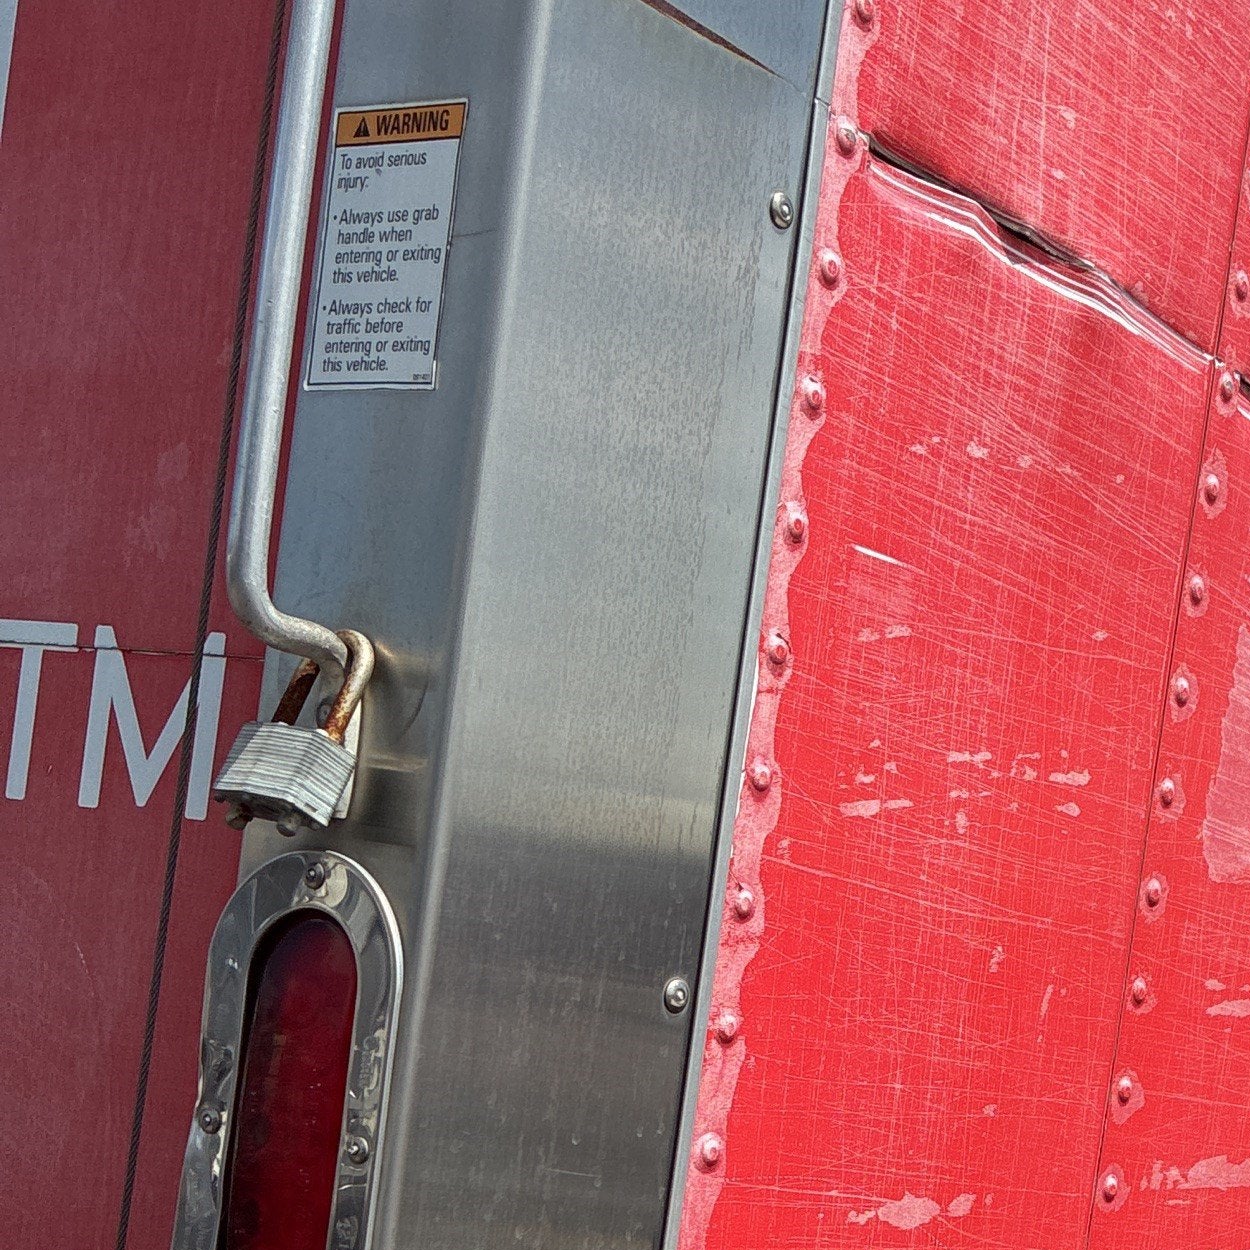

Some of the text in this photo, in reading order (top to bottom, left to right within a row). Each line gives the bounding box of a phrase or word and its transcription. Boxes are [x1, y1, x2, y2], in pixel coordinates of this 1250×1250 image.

[376, 110, 450, 136] WARNING
[341, 150, 427, 170] To avoid serious
[337, 173, 369, 192] injury:
[339, 204, 439, 226] Always use grab
[337, 227, 412, 245] handle when
[335, 245, 441, 267] entering or exiting
[333, 265, 399, 284] this vehicle.
[328, 297, 432, 319] Always check for
[327, 315, 404, 335] traffic before
[325, 335, 431, 357] entering or exiting
[322, 354, 389, 374] this vehicle.
